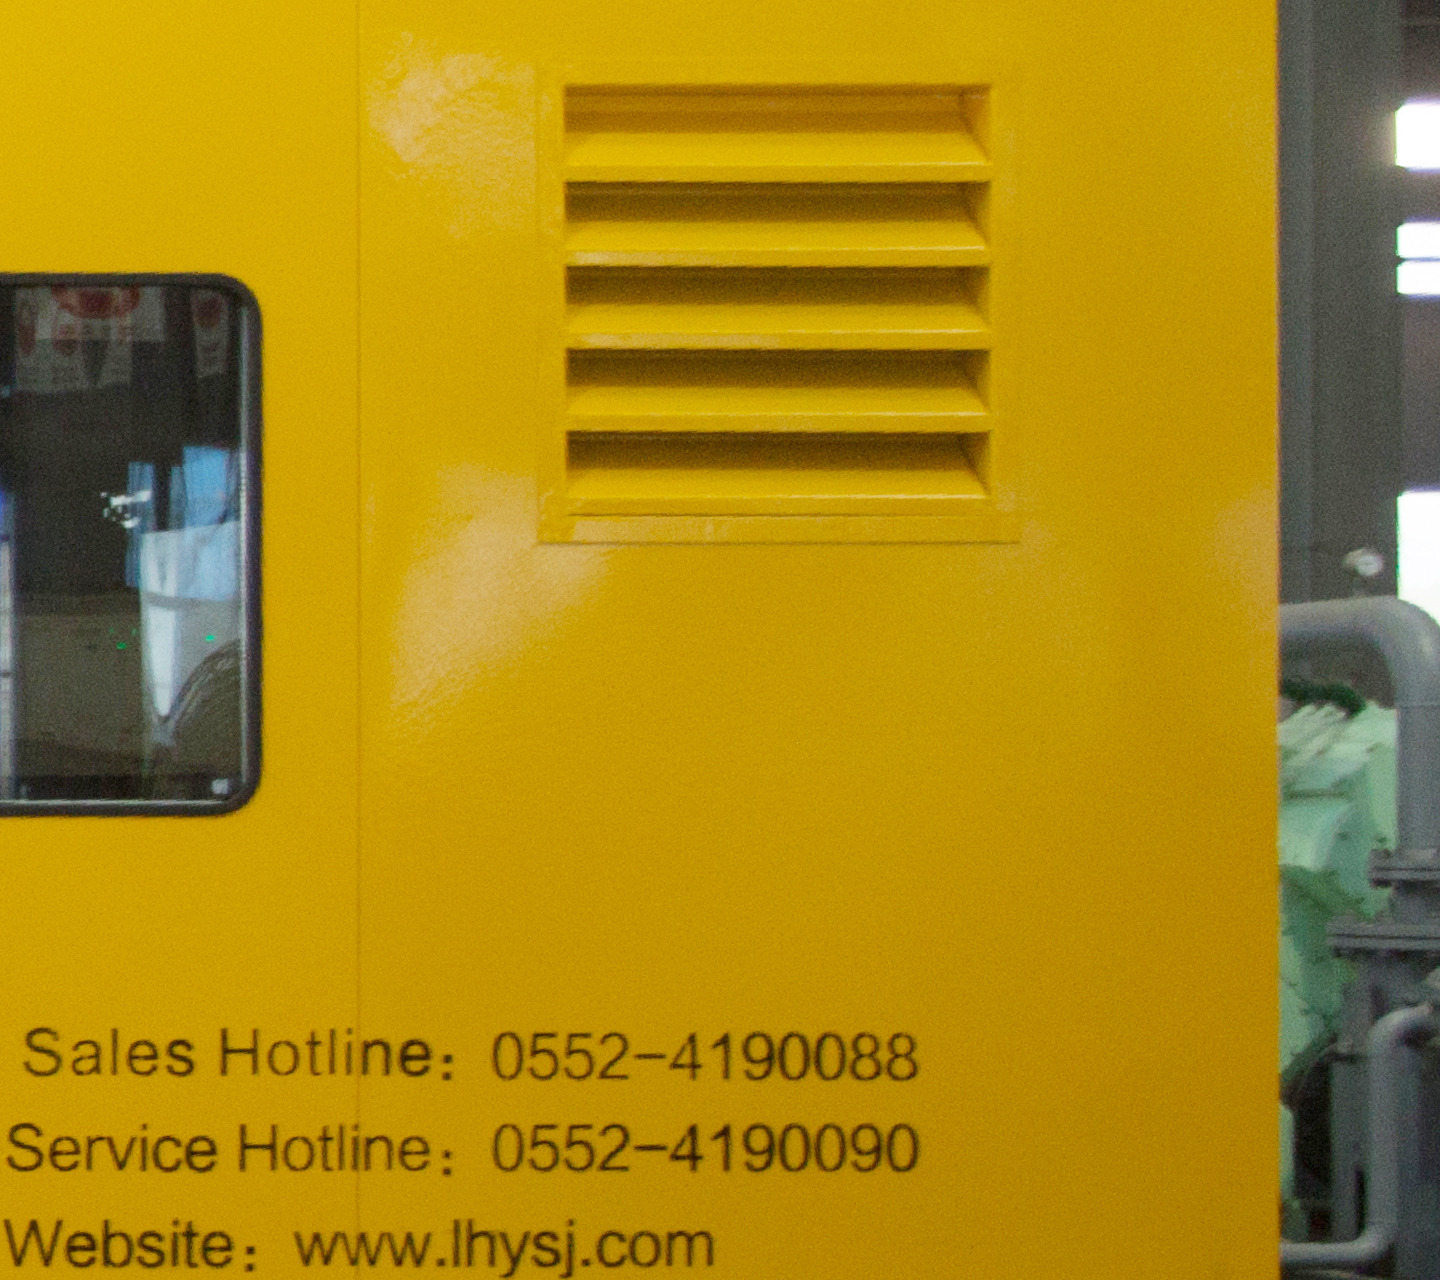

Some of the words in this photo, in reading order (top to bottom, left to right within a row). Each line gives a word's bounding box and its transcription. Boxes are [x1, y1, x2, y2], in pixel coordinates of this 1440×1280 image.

[22, 1027, 195, 1079] Sales
[491, 1031, 920, 1082] 0552-4190088
[5, 1122, 218, 1174] Service
[492, 1122, 921, 1174] 0552-4190090
[293, 1218, 716, 1280] www.lhysj.com
